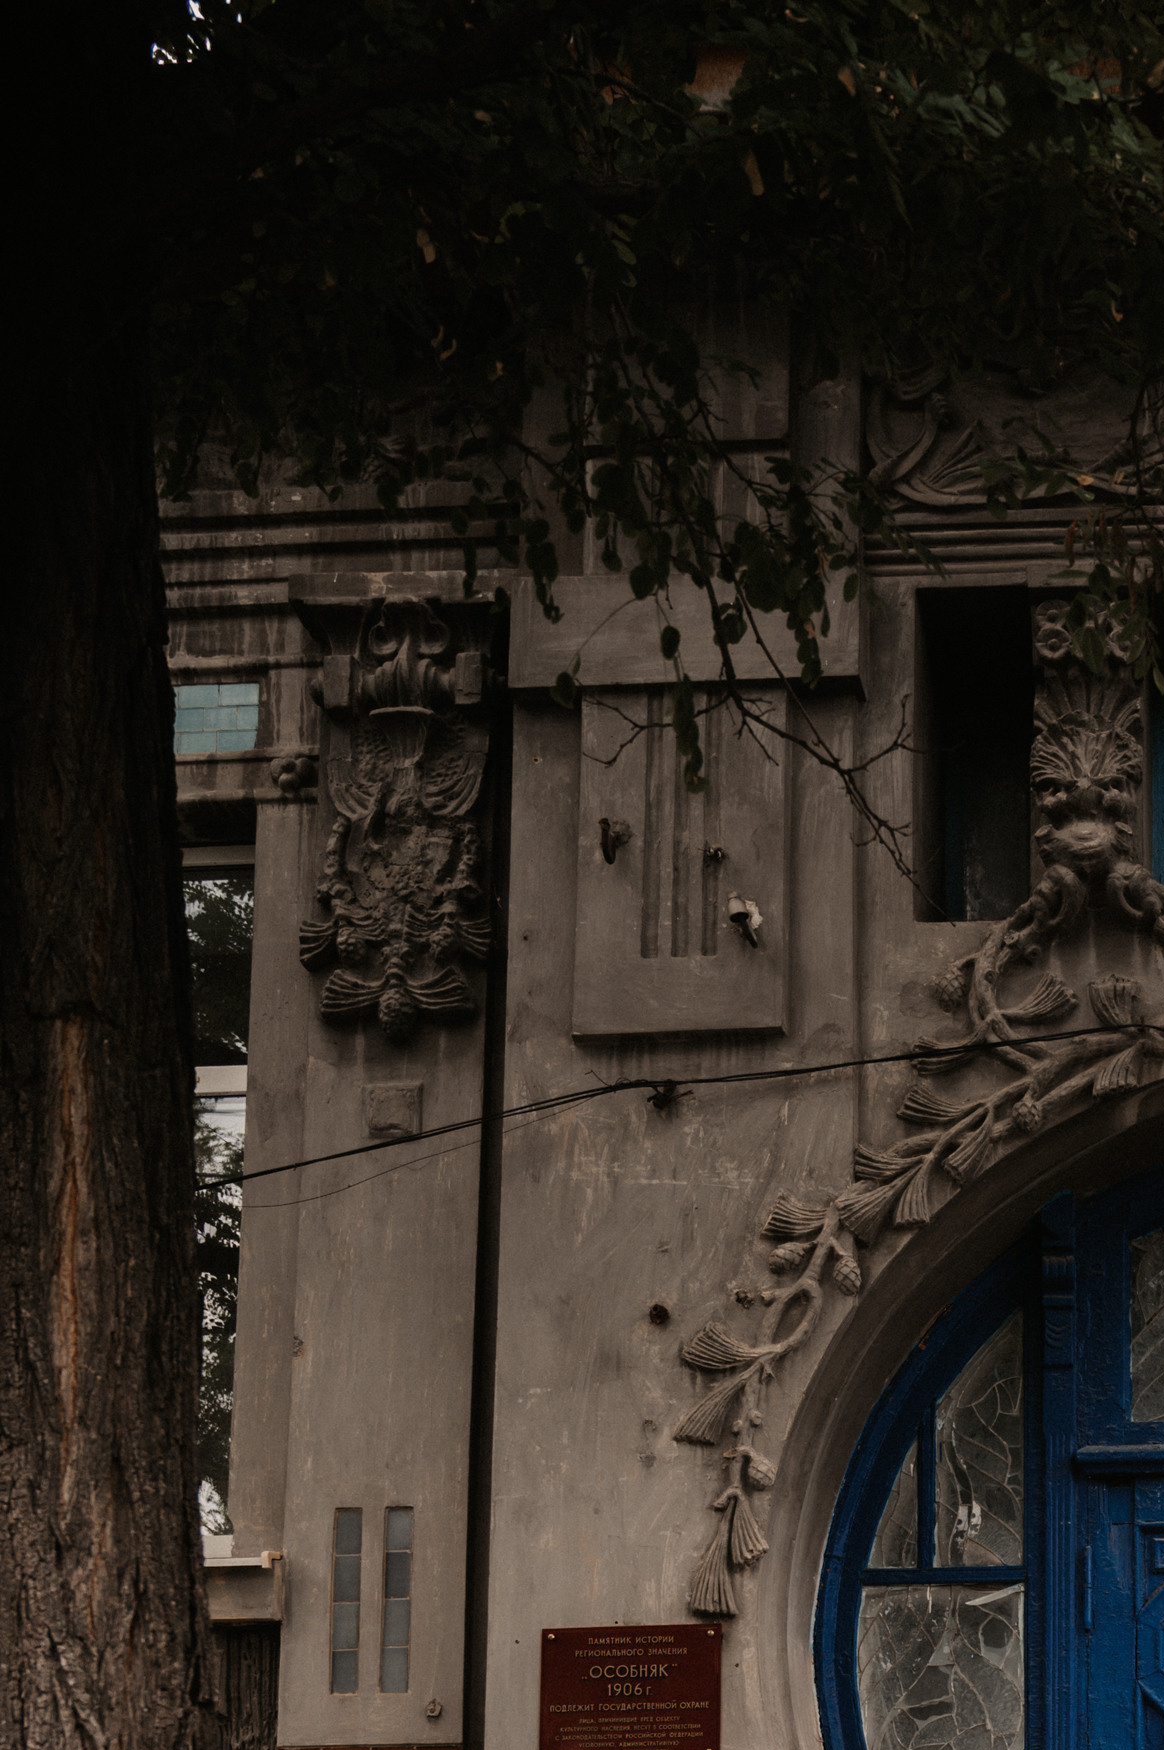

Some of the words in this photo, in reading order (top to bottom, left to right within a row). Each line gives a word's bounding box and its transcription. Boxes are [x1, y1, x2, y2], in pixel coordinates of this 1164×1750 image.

[588, 1637, 631, 1645] ПАМЯТНИК
[636, 1636, 674, 1644] ИСТОРИИ
[575, 1649, 644, 1657] РЕГИОНАЛЬНОГО
[608, 1683, 642, 1696] 1906
[550, 1704, 594, 1713] ПОДЛЕЖИТ
[599, 1700, 676, 1711] ГОСУДАРСТВЕННОЙ
[680, 1701, 709, 1709] ОХРАНЕ
